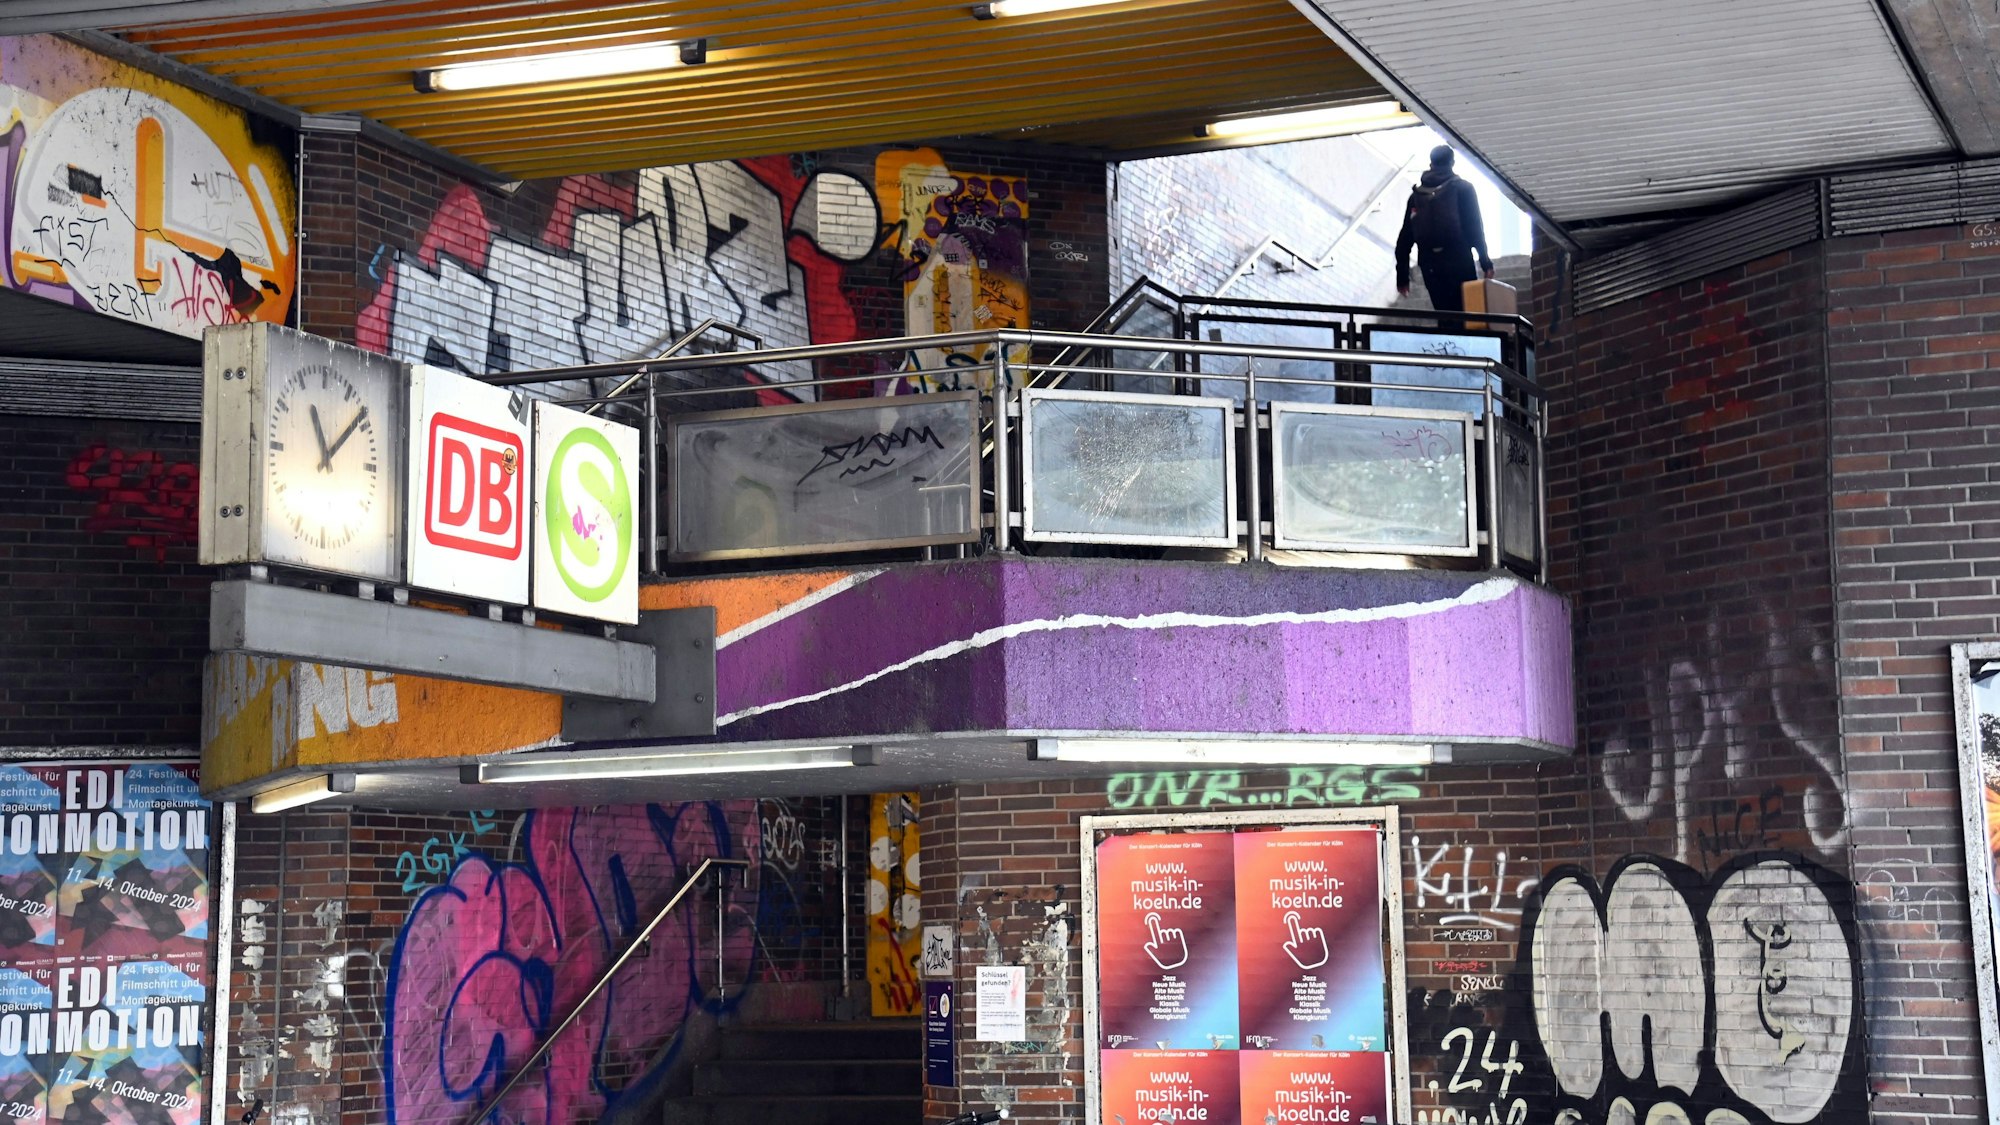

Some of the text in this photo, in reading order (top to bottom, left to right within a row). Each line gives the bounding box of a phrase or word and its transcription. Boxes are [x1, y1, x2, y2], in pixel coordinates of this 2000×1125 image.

[439, 437, 516, 536] DB
[560, 441, 619, 588] S
[45, 772, 60, 781] für
[149, 769, 188, 779] Festival
[191, 768, 200, 778] fü
[40, 787, 59, 797] und
[66, 769, 125, 810] EDI
[128, 784, 200, 795] Filmschnitt un
[128, 799, 199, 810] Montagekunst
[64, 810, 206, 853] MOTION
[1145, 862, 1187, 874] www.
[1284, 860, 1328, 873] www.
[1131, 875, 1203, 892] musik-in-
[1269, 874, 1344, 891] musik-in-
[119, 881, 169, 905] Oktober
[169, 894, 202, 913] 2024
[1133, 893, 1202, 910] koeln.de
[1272, 891, 1343, 909] koeln.de
[19, 899, 54, 919] 2024
[36, 969, 52, 979] für
[142, 964, 182, 975] Festival
[185, 963, 201, 973] für
[31, 985, 50, 995] und
[57, 965, 118, 1009] EDI
[122, 978, 201, 991] Filmschnitt und
[981, 979, 1011, 987] gefunden?
[121, 994, 193, 1007] Montagekunst
[1153, 1013, 1187, 1021] Klangkunst
[55, 1005, 199, 1054] MOTION
[1150, 1071, 1192, 1084] www.
[1290, 1072, 1334, 1085] www.
[111, 1080, 160, 1104] Oktober
[161, 1093, 194, 1111] 2024
[1136, 1085, 1209, 1102] musik-in-
[1275, 1086, 1351, 1103] musik-in-
[8, 1101, 42, 1121] 2024
[1278, 1104, 1350, 1122] koeln.de
